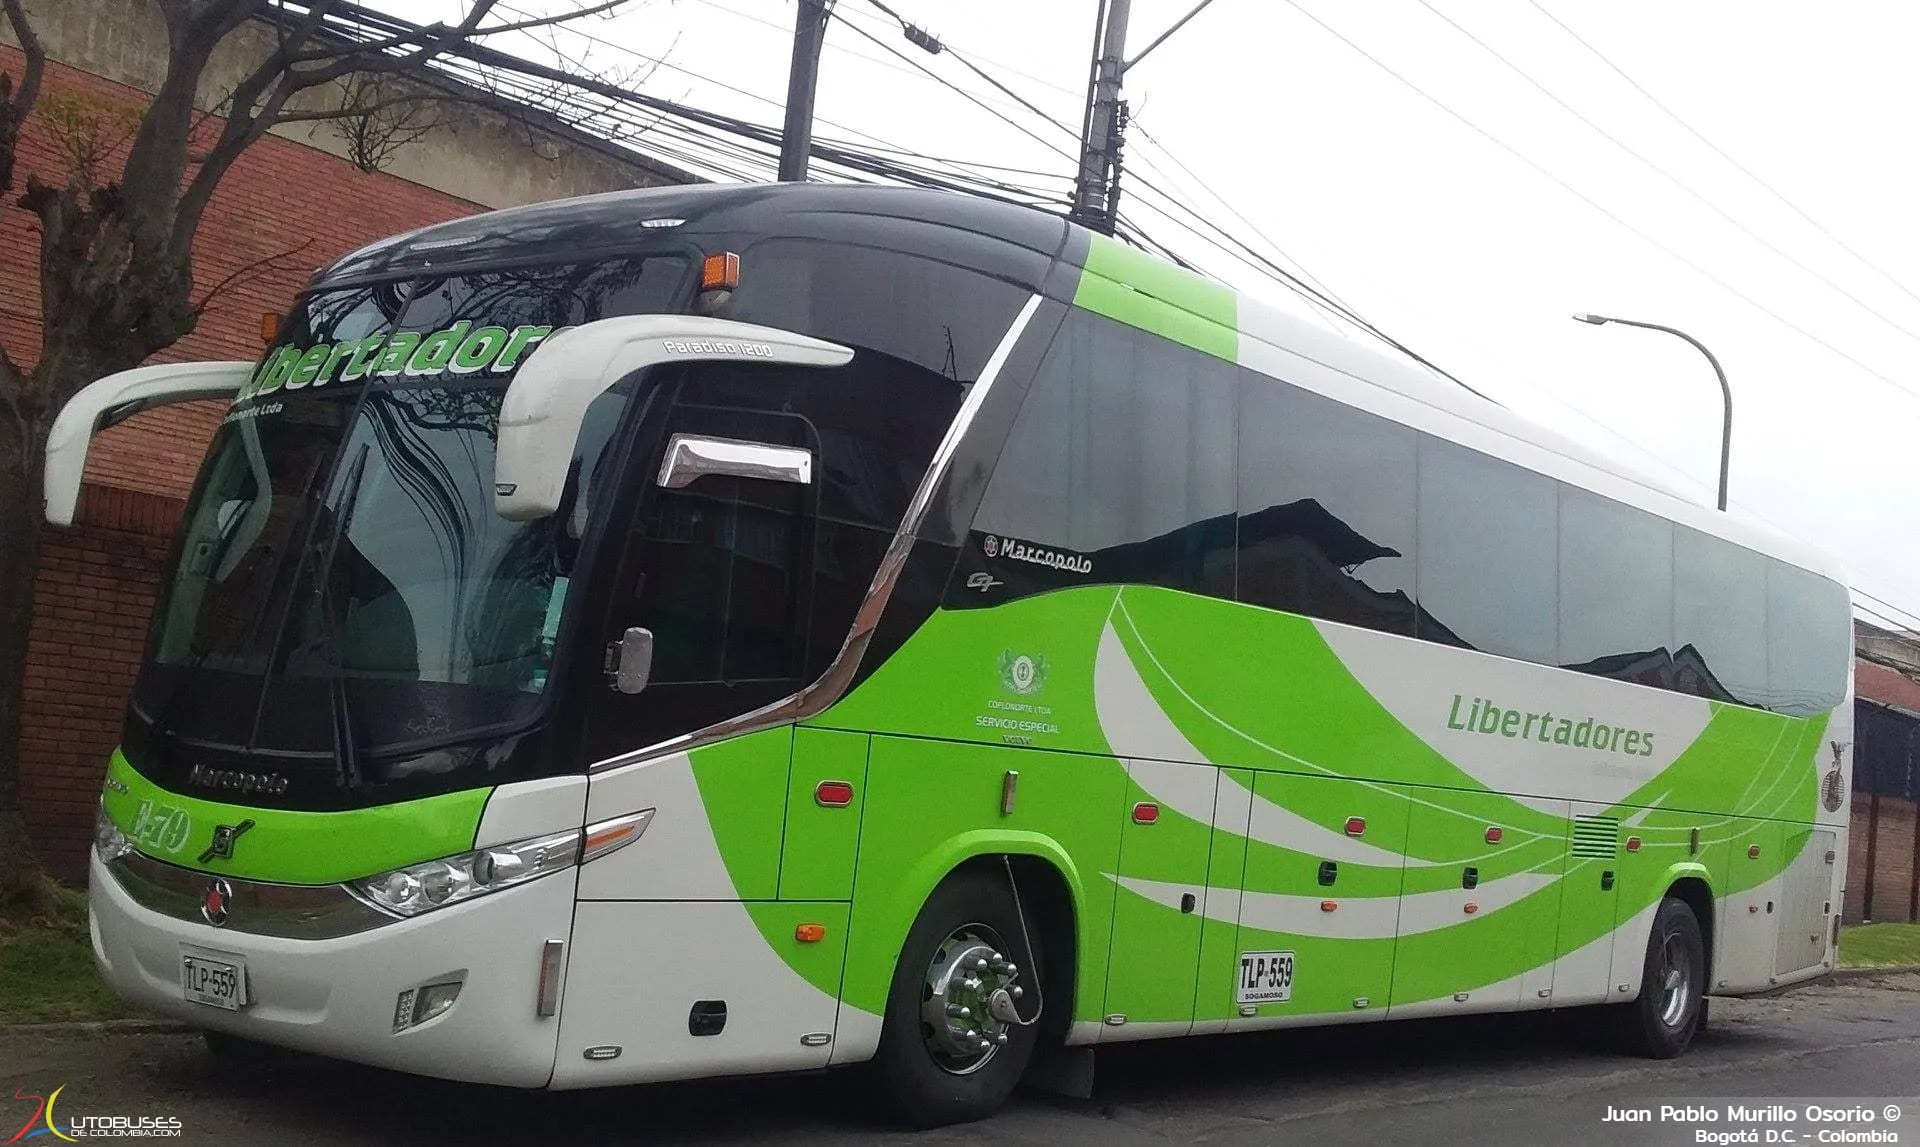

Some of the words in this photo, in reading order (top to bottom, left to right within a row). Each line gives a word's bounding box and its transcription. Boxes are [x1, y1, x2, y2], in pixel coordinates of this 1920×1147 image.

[663, 340, 736, 353] Paradiso
[740, 344, 773, 357] 1200
[1000, 538, 1092, 573] Marcopolo
[976, 715, 1018, 730] SERVICIO
[1018, 720, 1060, 734] ESPECIAL
[1447, 694, 1655, 757] Libertadores
[184, 962, 236, 999] TLP-559
[1241, 956, 1293, 989] TLP-559
[1245, 991, 1283, 1000] SOGAMOSO
